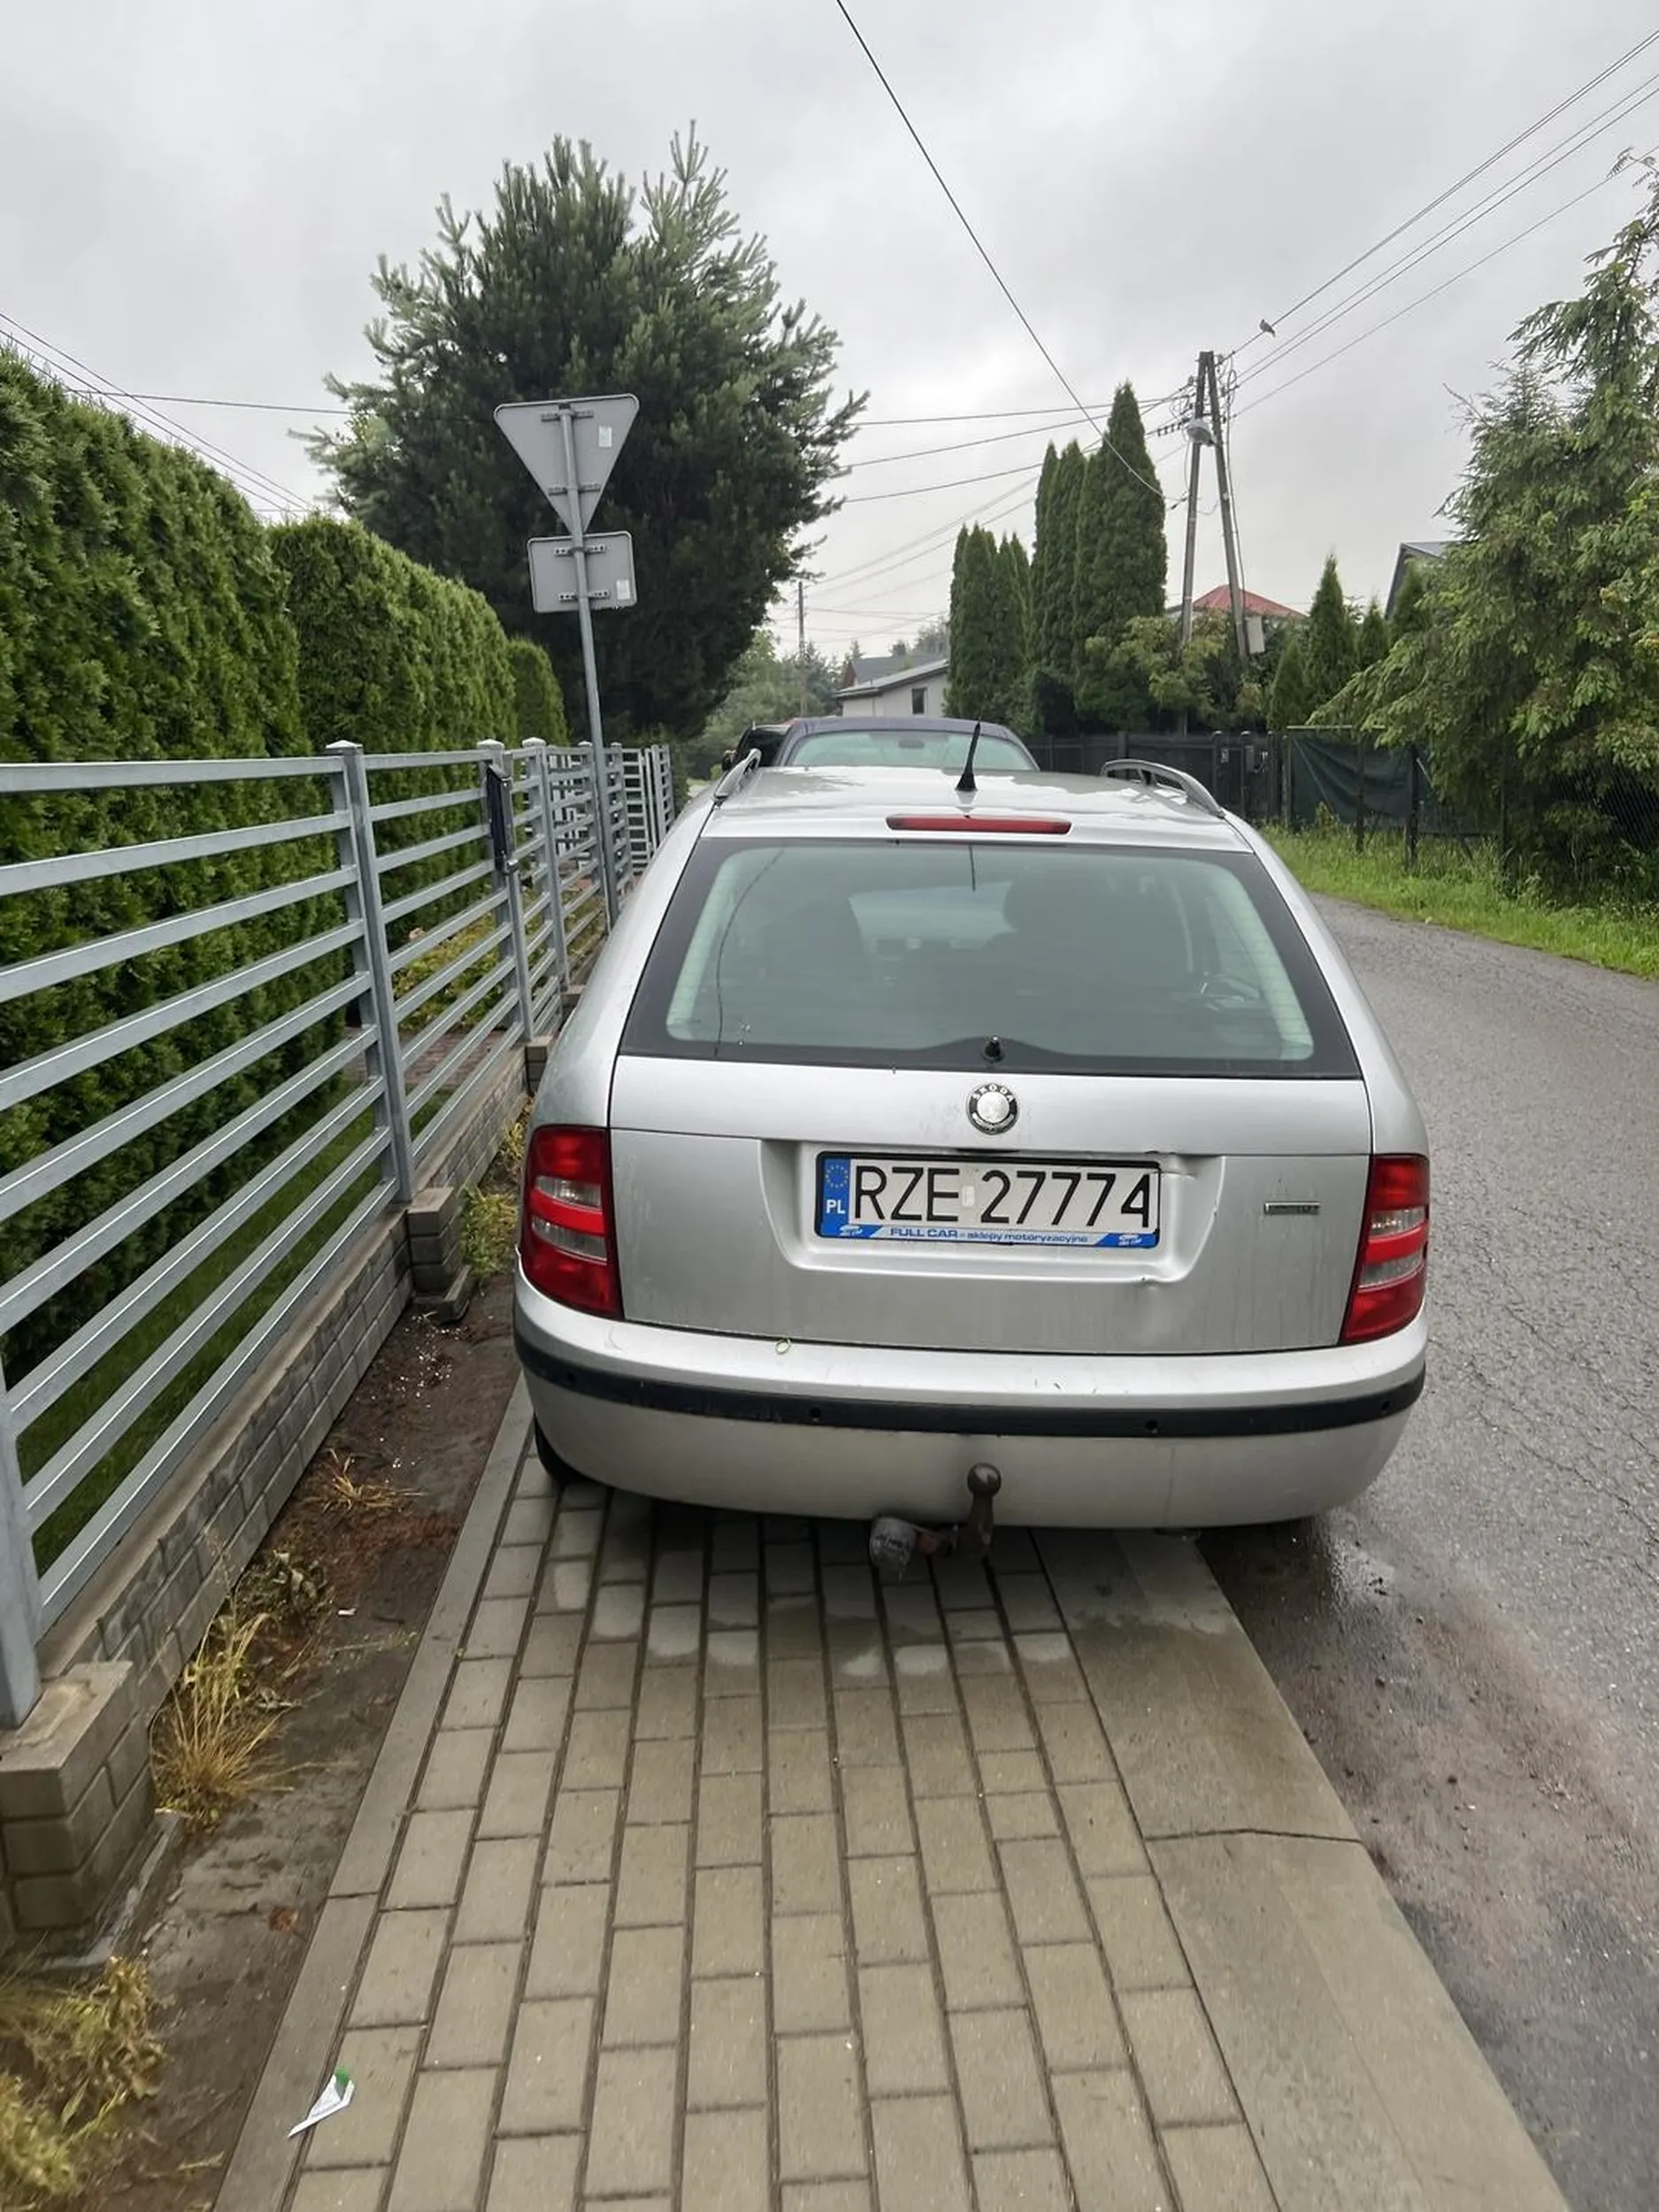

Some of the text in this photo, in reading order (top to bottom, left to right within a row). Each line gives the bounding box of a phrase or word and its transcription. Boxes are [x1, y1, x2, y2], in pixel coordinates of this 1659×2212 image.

[855, 1166, 1149, 1228] RZE 27774
[826, 1199, 846, 1214] PL
[890, 1227, 924, 1237] FULL
[926, 1228, 957, 1238] CAR
[967, 1231, 1003, 1241] sklepy
[1003, 1233, 1088, 1244] motoryzacyjne
